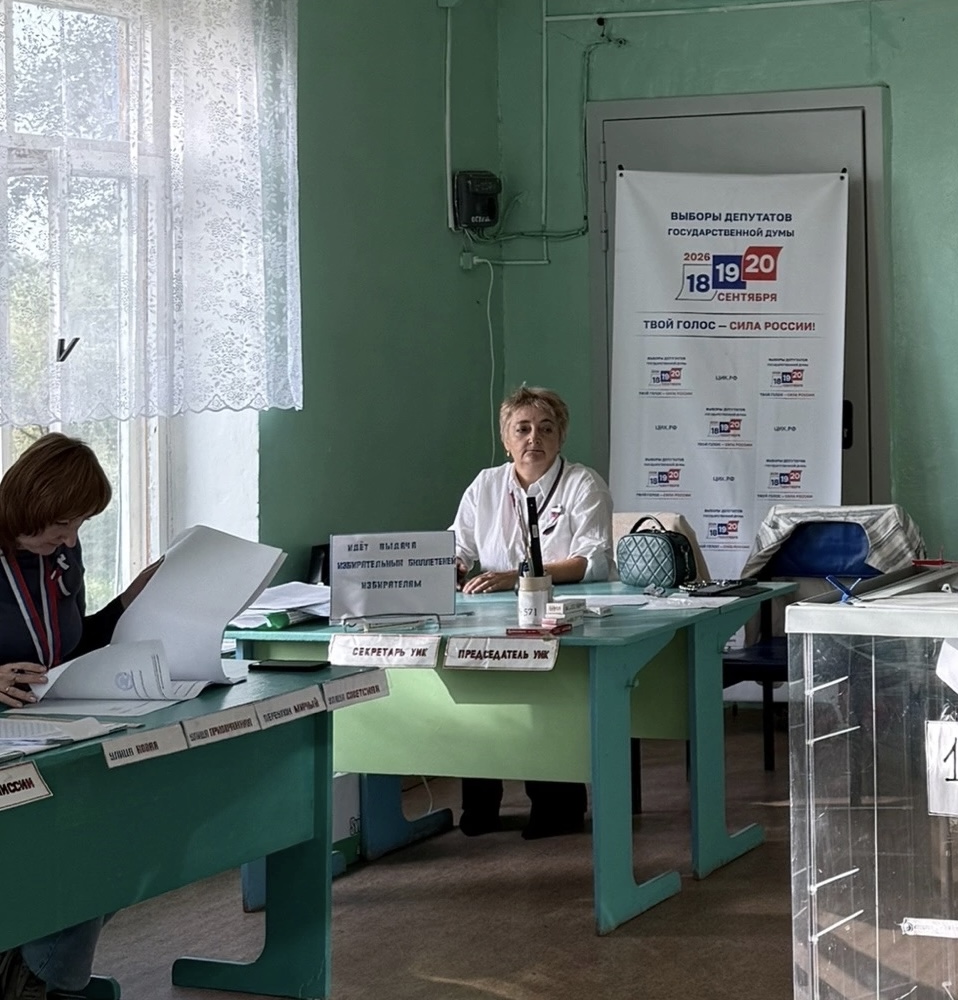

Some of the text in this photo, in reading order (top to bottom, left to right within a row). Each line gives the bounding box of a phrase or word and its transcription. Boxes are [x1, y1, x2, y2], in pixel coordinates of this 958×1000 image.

[671, 212, 793, 222] ВЫБОРЫ ДЕПУТАТОВ
[668, 228, 795, 237] ГОСУДАРСТВЕННОЙ ДУМЫ
[684, 252, 711, 261] 2026
[686, 254, 775, 293] 18 19 20
[717, 293, 777, 302] СЕНТЯБРЯ
[643, 318, 673, 330] ТВОЙ
[676, 320, 716, 330] ГОЛОС
[729, 321, 761, 331] СИЛА
[764, 321, 816, 331] РОССИИ!
[361, 580, 422, 590] ИЗБИРАТЕЛЯМ
[352, 647, 428, 657] СЕКРЕТАРЬ УИК
[457, 649, 550, 661] ПРЕДСЕДАТЕЛЬ УИК
[0, 777, 36, 796] ИССИИ
